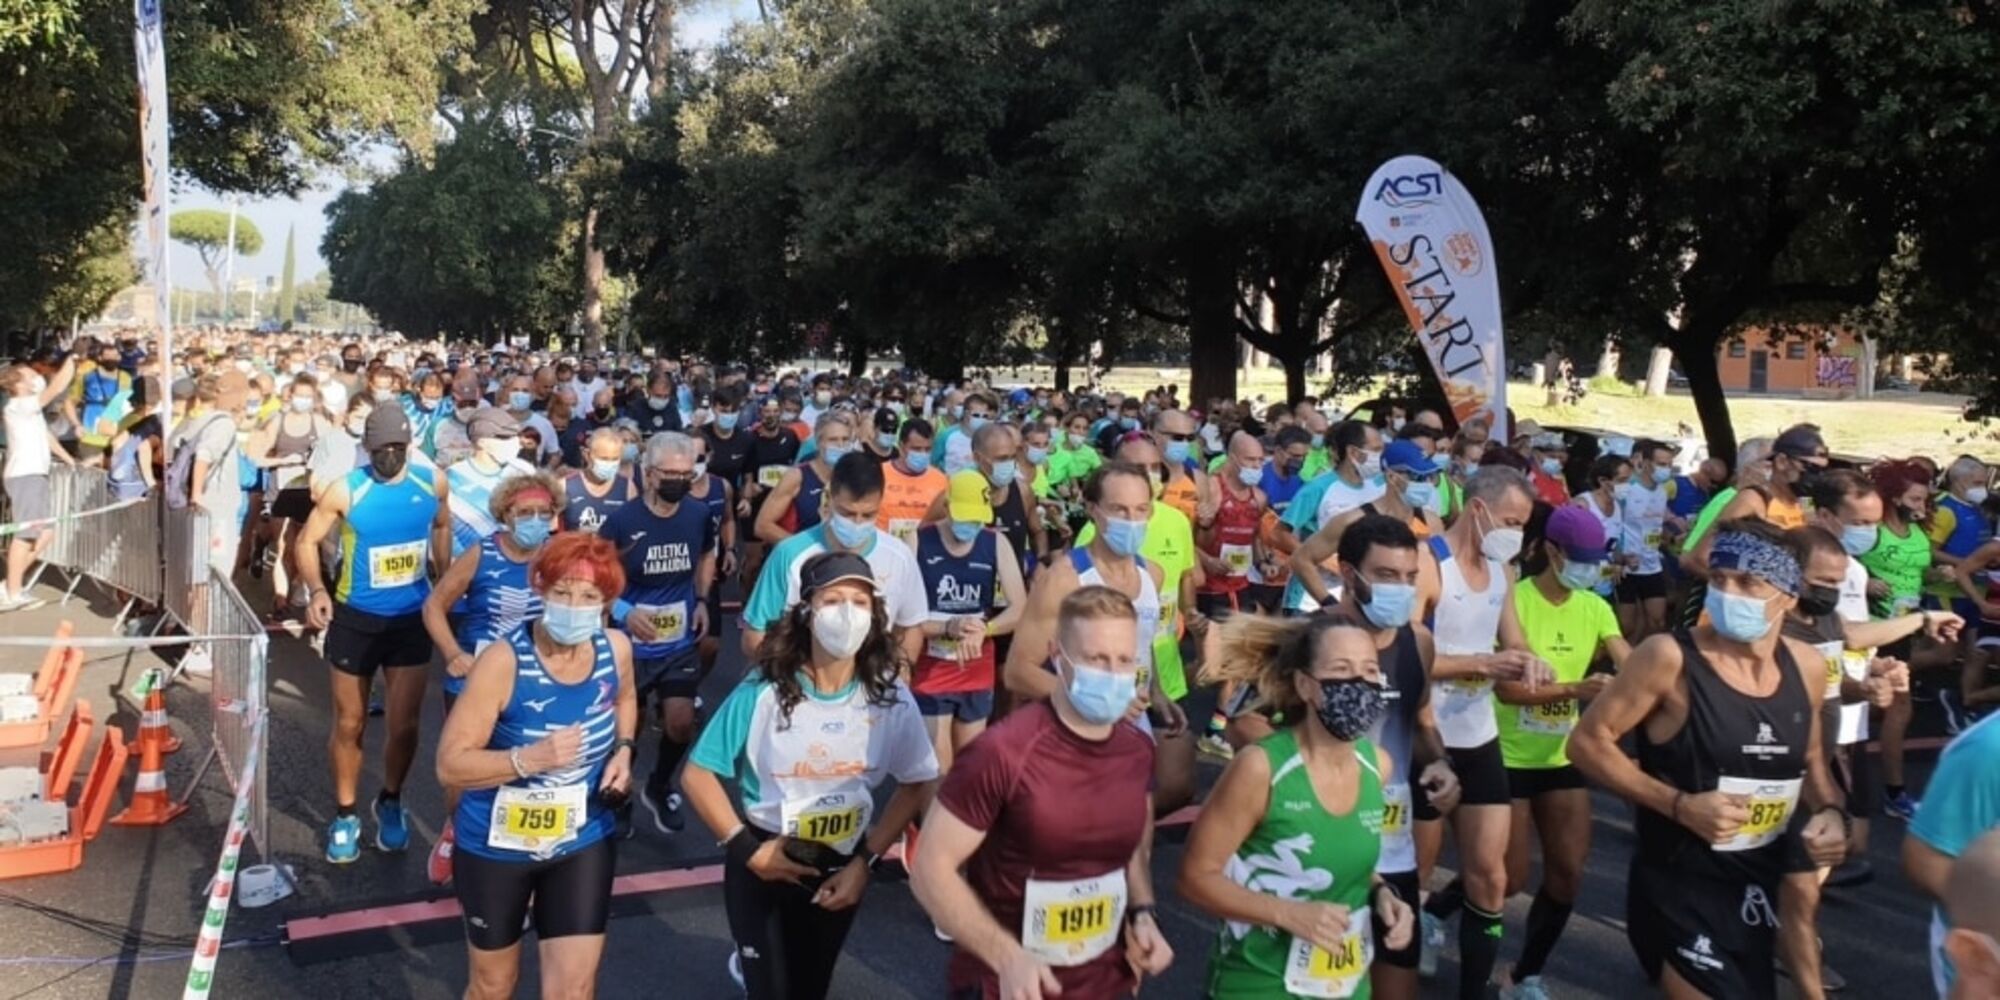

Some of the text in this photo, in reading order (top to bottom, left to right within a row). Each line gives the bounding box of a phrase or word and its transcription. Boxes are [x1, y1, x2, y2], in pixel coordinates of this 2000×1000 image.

[1389, 234, 1491, 378] START
[385, 554, 414, 572] 1570
[937, 575, 981, 601] RUN
[518, 807, 557, 830] 759
[808, 811, 852, 837] 1701
[1743, 802, 1787, 826] 873
[1059, 901, 1105, 933] 1911
